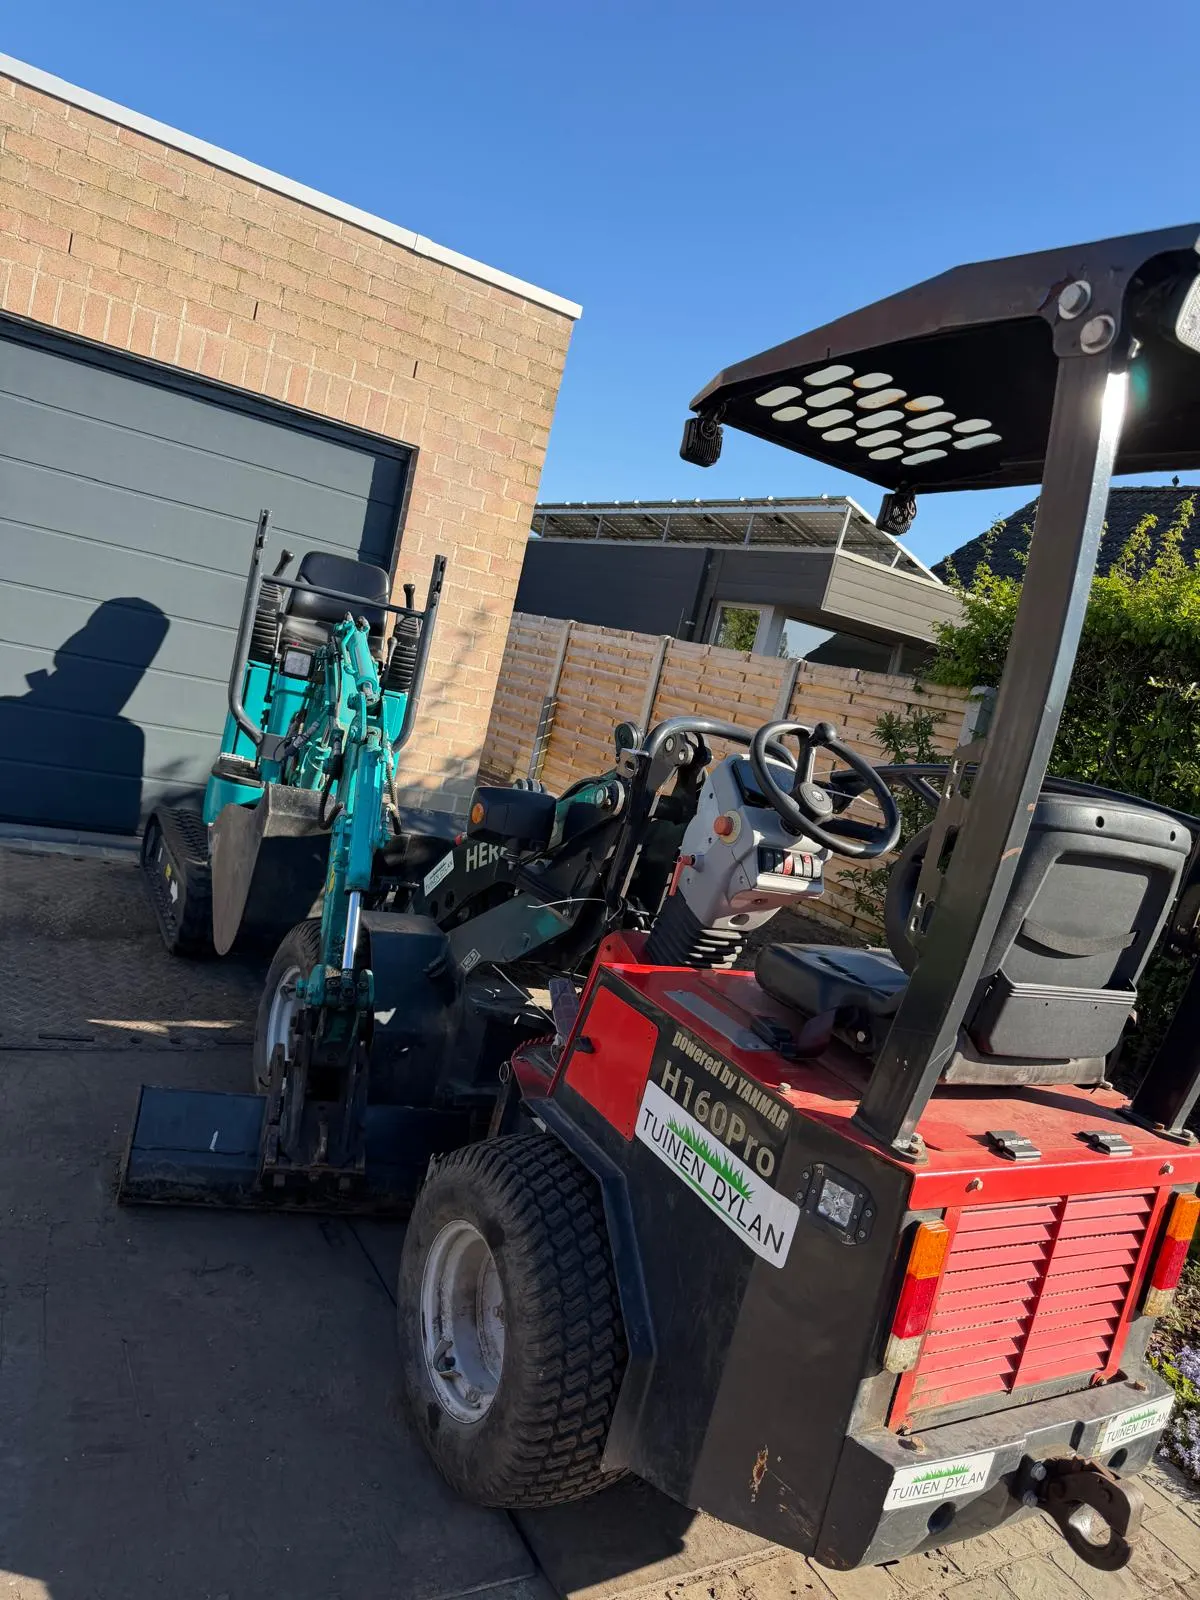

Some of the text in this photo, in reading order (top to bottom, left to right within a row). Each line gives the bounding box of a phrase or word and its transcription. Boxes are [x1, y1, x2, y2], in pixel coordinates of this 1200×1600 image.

[661, 1059, 775, 1177] H160Pro
[672, 1031, 789, 1130] powered by YANMAR
[642, 1107, 785, 1254] TUINEN DYLAN
[1107, 1412, 1168, 1442] TUINEN DYLAN
[893, 1470, 986, 1500] TUINEN DYLAN
